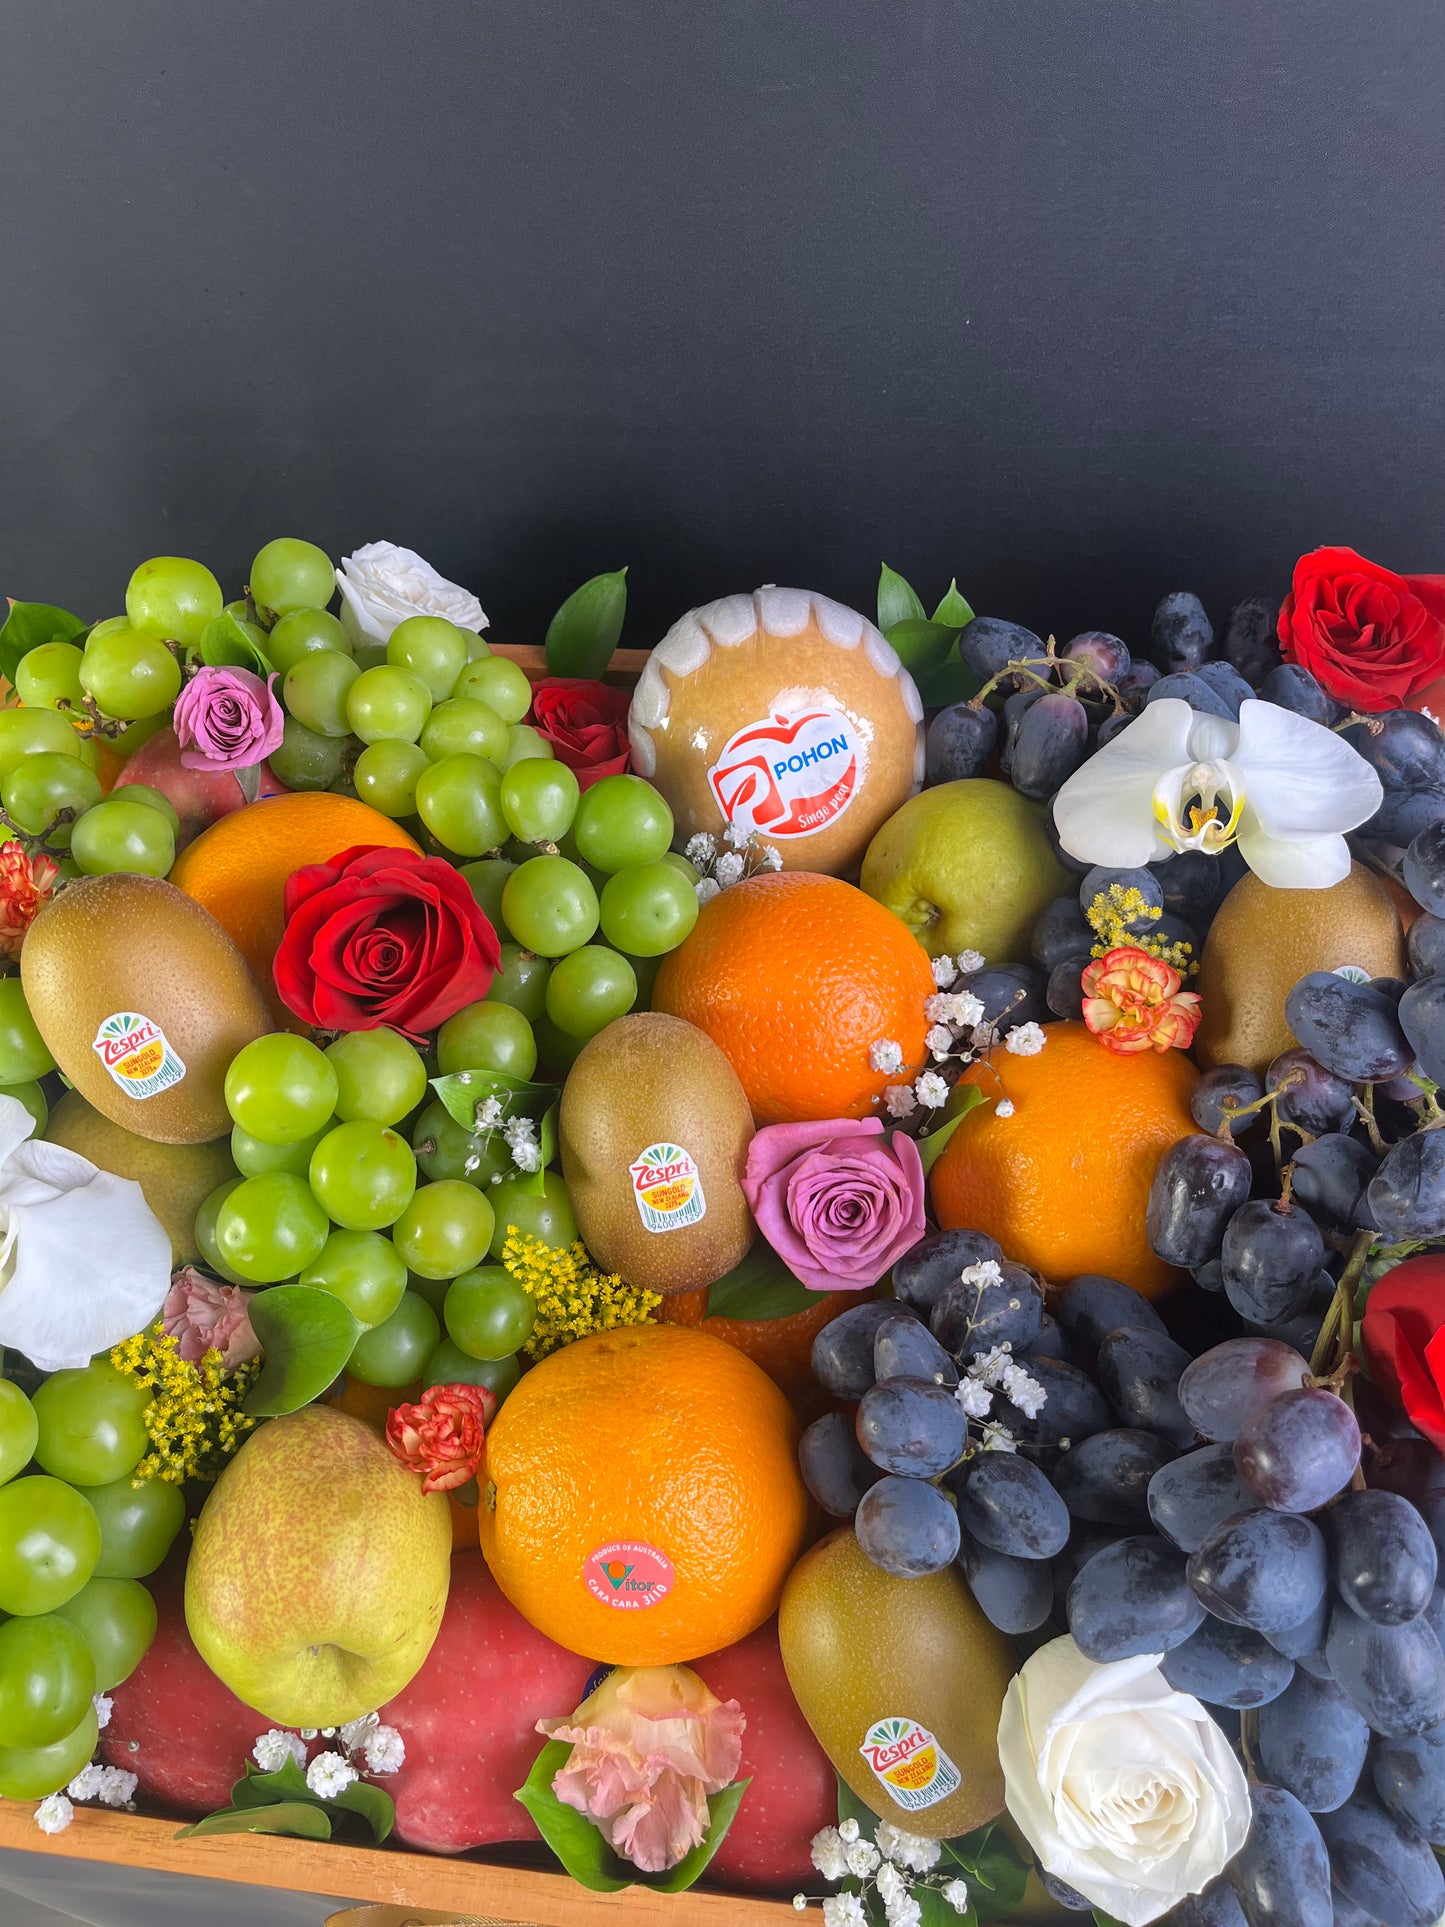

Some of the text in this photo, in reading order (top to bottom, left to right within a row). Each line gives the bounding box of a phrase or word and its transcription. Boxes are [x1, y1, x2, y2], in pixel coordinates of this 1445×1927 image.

[773, 733, 849, 781] POHON
[797, 806, 829, 829] Singo
[95, 1021, 155, 1065] Zespri
[123, 1048, 156, 1069] SUNGOLD
[126, 1054, 161, 1075] NEW ZEALAND
[136, 1070, 182, 1098] 9400 1129
[632, 1157, 690, 1191] Zespri
[651, 1184, 686, 1199] SUNGOLD
[652, 1191, 689, 1205] NEW ZEALAND
[651, 1211, 700, 1231] 9400 1129
[591, 1544, 621, 1563] PRODUCE
[633, 1545, 668, 1570] AUSTRALIA
[588, 1579, 667, 1608] CARA CARA 3110
[863, 1726, 926, 1773] Zespri
[893, 1756, 929, 1779] SUNGOLD
[896, 1762, 934, 1785] NEW ZEALAND
[907, 1779, 957, 1809] 9400 1129
